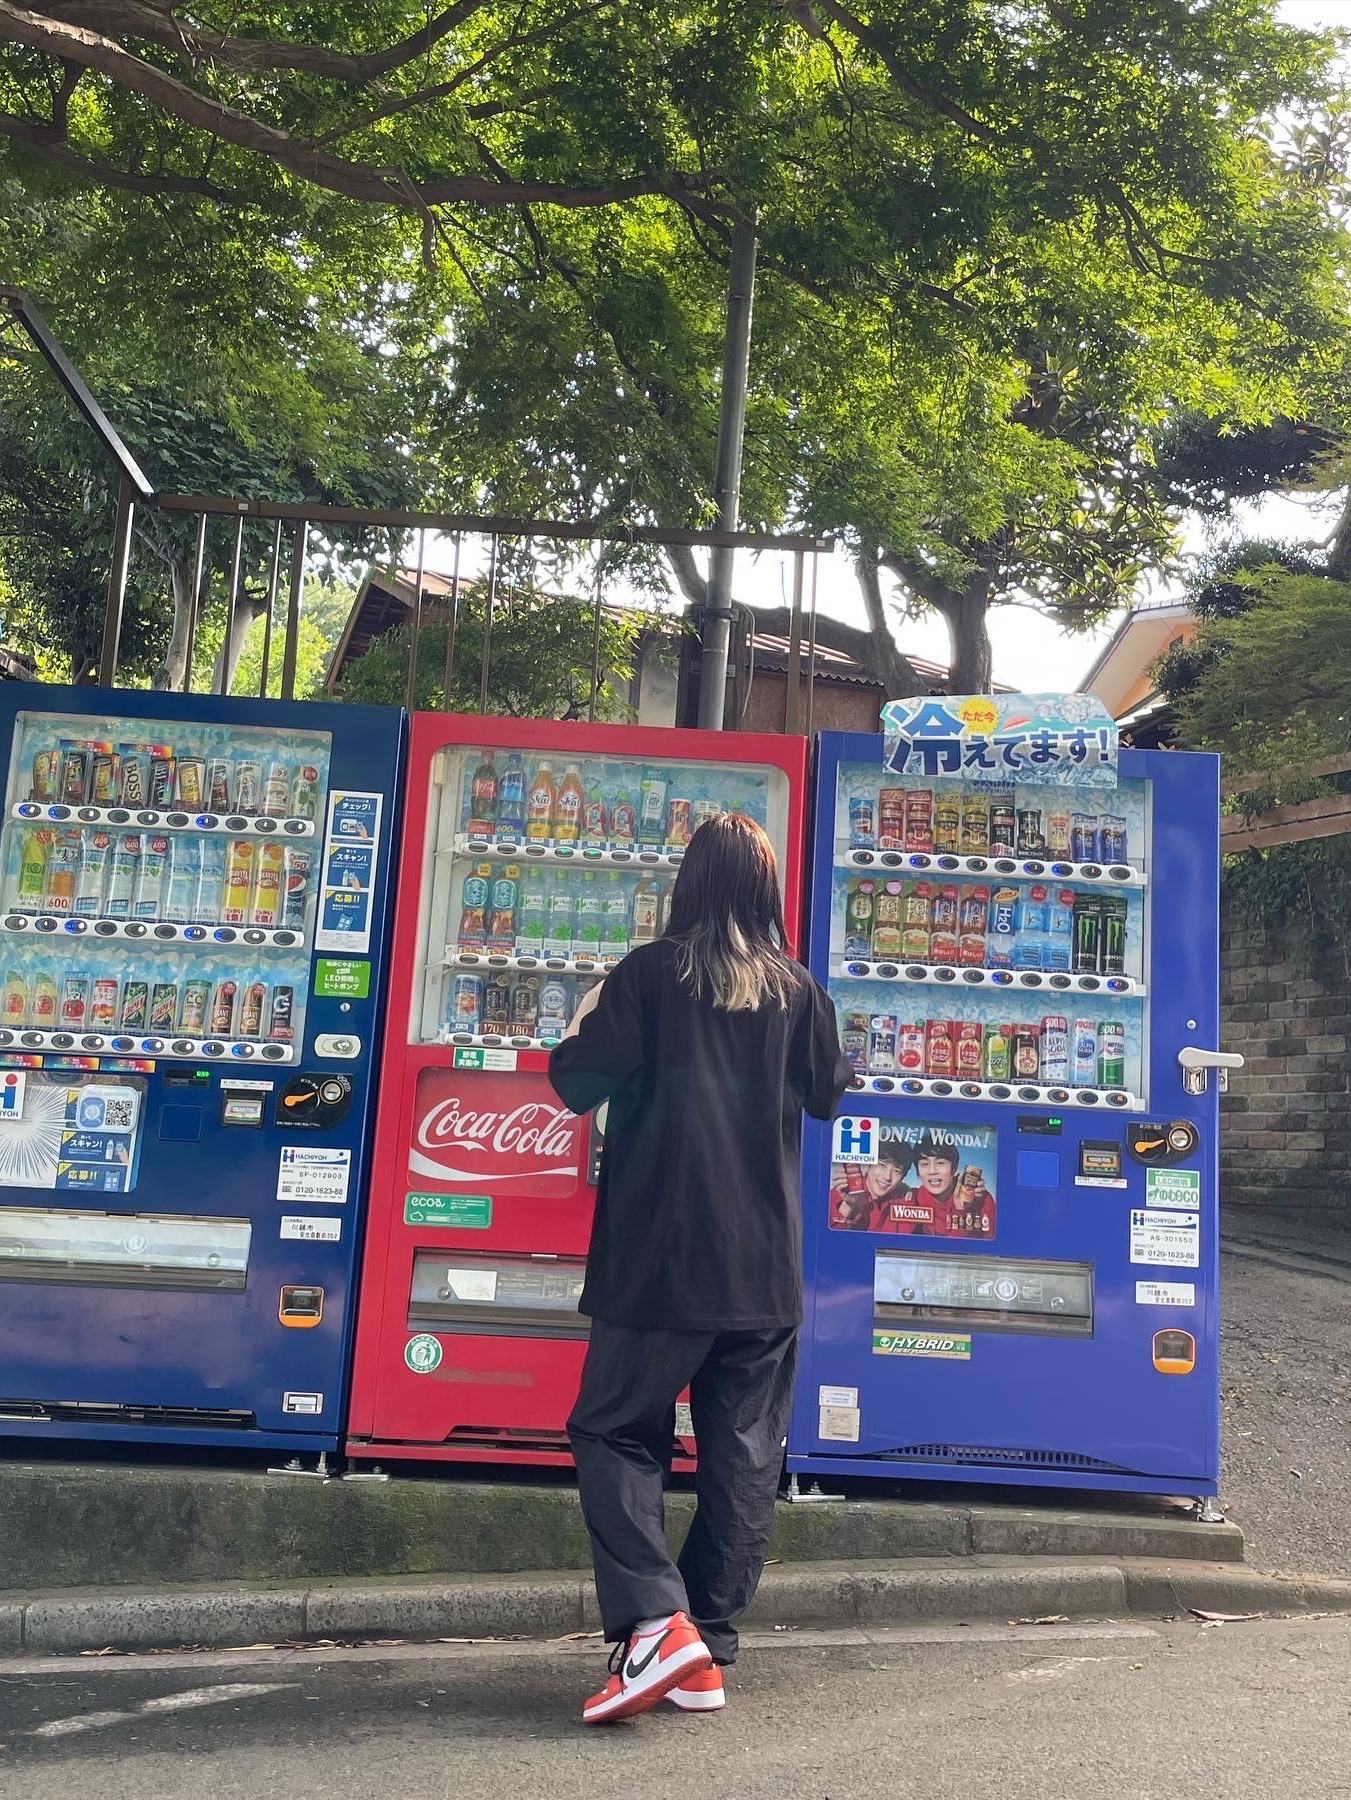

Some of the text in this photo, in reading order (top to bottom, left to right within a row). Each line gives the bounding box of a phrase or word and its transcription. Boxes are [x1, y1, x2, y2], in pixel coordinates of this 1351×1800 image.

[962, 710, 995, 724] ただ今
[889, 703, 1110, 776] 冷えてます!
[126, 762, 142, 802] BOSS
[342, 802, 371, 812] チェック!
[336, 853, 367, 862] スキャン!
[48, 898, 68, 909] 600
[324, 982, 360, 991] ヒートポンプ
[418, 1097, 584, 1157] Coca-Cola
[70, 1140, 103, 1149] スキャン!
[296, 1153, 328, 1161] HACHIYOH
[835, 1153, 875, 1162] HACHIYOH
[894, 1205, 930, 1219] WONDA
[1144, 1216, 1177, 1225] HACHIYOH
[889, 1337, 956, 1353] HYBRID
